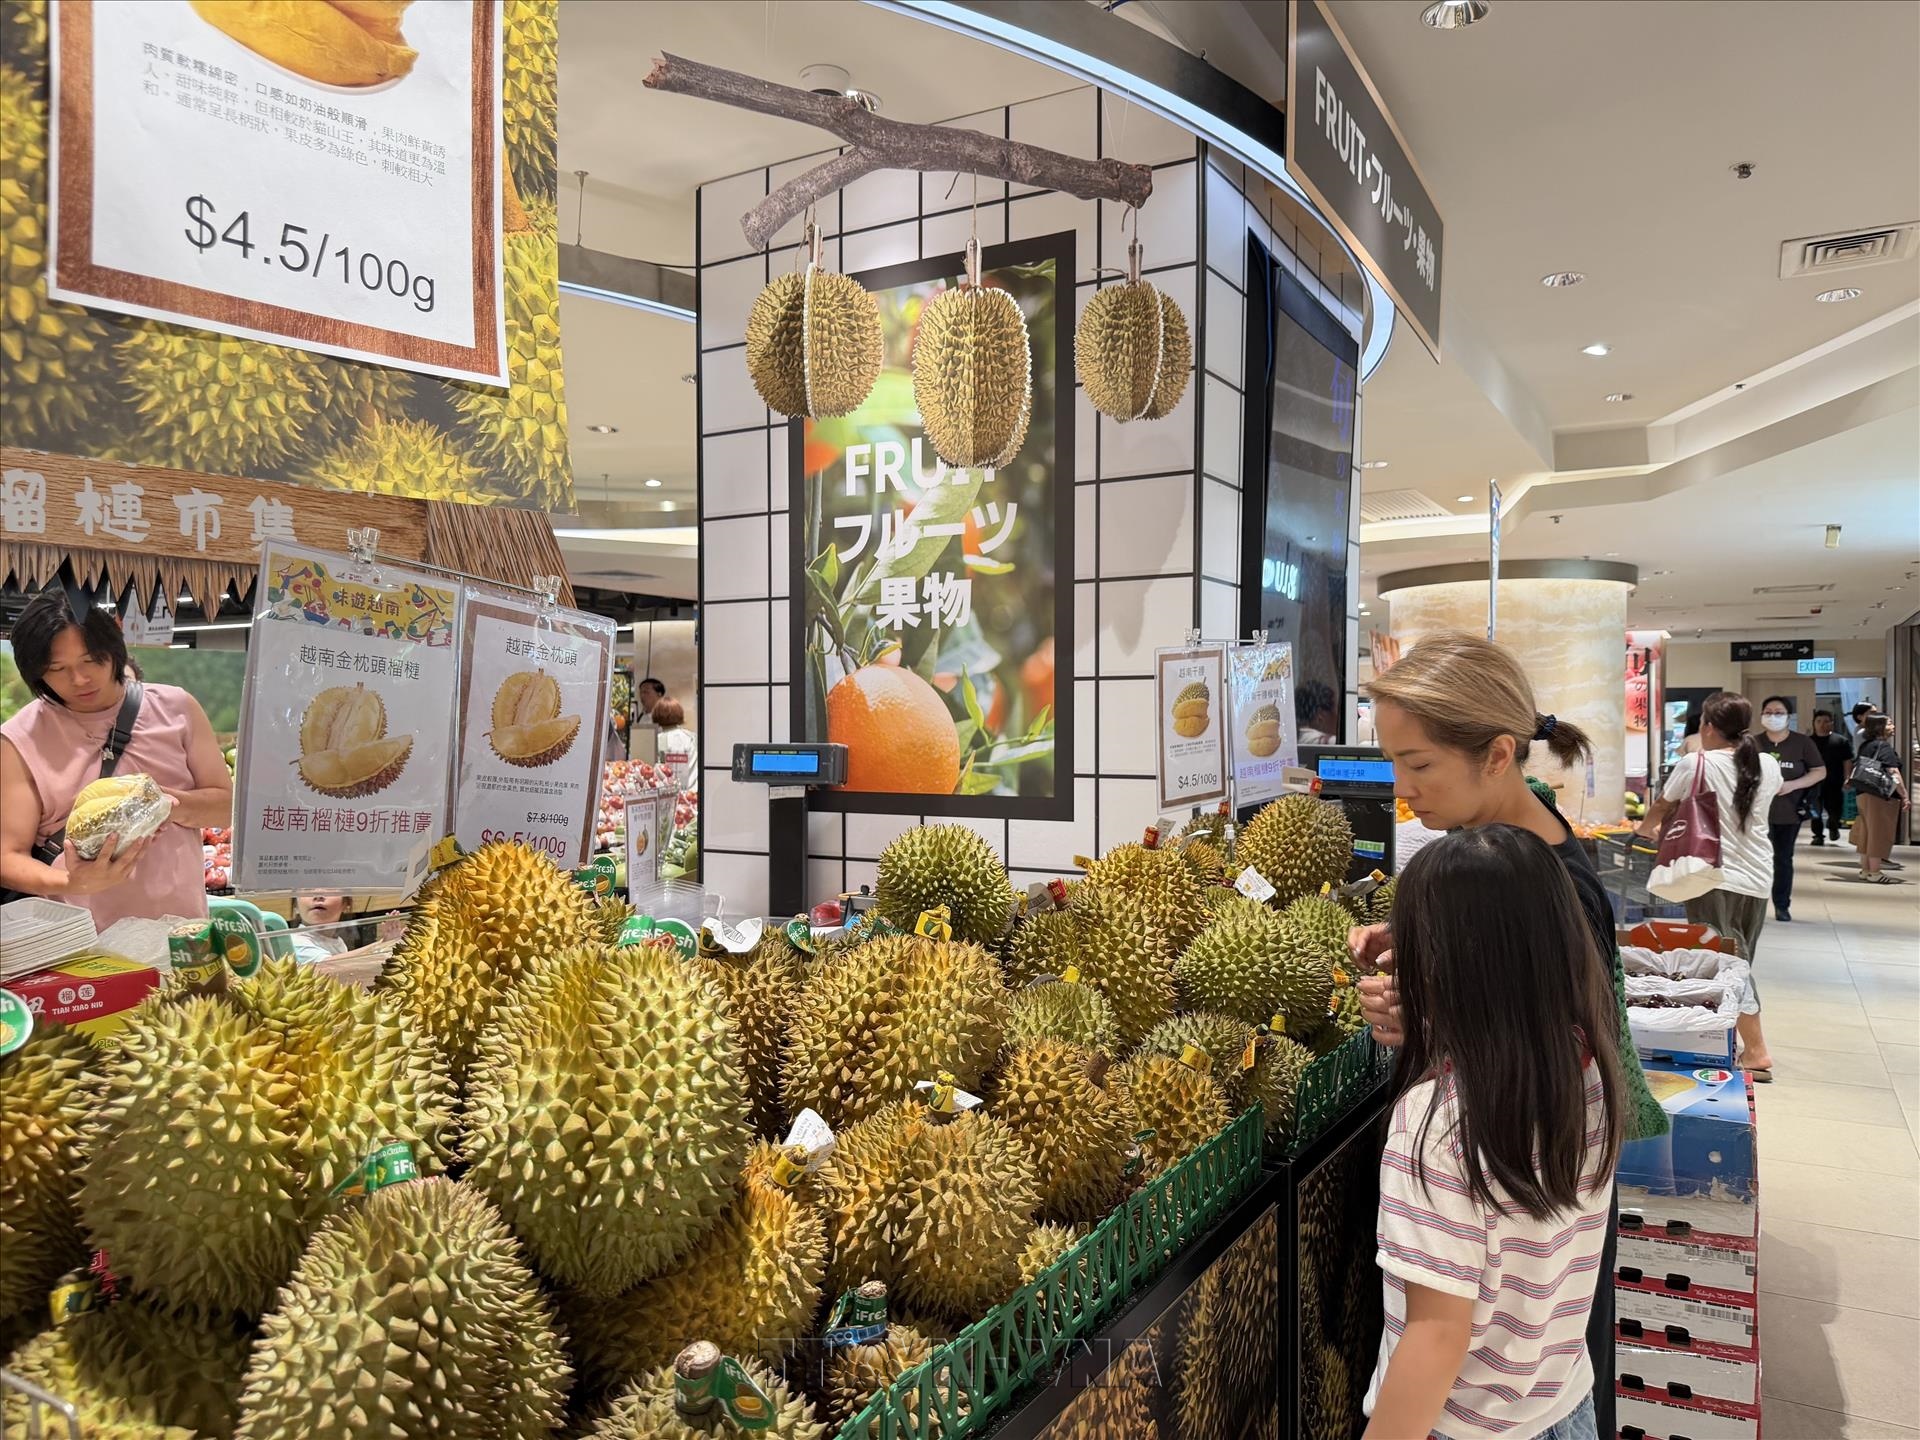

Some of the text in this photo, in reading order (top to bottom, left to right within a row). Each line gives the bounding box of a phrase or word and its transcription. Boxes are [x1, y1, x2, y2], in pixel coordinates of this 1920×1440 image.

[185, 193, 436, 312] $4.5/100g
[845, 437, 996, 496] FRU
[834, 502, 1018, 564] フルーツ
[876, 572, 972, 631] 果物
[299, 644, 420, 681] 越南金枕頭榴槤
[505, 636, 579, 667] 越南金枕頭
[1178, 773, 1217, 790] $4.5/100g
[261, 805, 433, 835] 越南榴槤9折推廣
[526, 812, 569, 827] $7.8/100g
[480, 828, 567, 858] $65/100g
[213, 917, 251, 934] iFresh
[52, 1007, 70, 1015] TIAN
